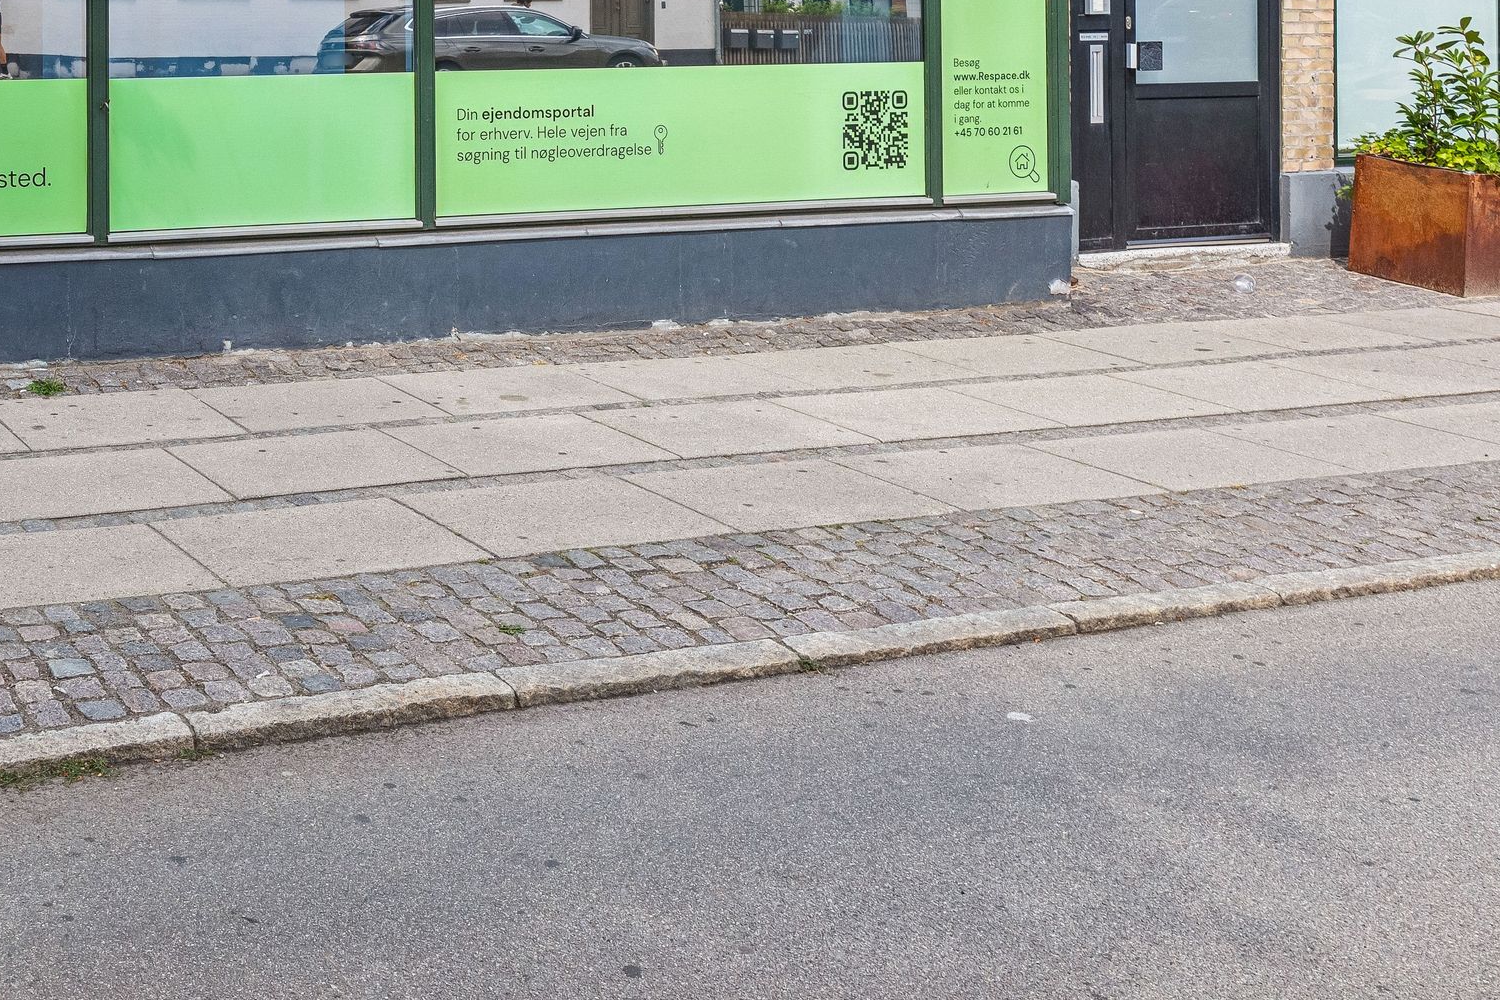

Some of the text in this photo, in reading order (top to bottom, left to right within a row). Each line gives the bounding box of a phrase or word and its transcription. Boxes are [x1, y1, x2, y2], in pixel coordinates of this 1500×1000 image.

[953, 57, 981, 70] Besøg
[953, 70, 1031, 83] www.Respace.dk
[953, 85, 1025, 96] eller kontakt os i
[953, 99, 1030, 112] dag for at komme
[457, 104, 595, 124] Din ejendomsportal
[954, 114, 982, 126] i gang.
[456, 123, 628, 142] for erhverv. Hele vejen fra
[954, 125, 1023, 138] +45 70 60 21 61
[456, 142, 652, 164] søgning til nøgleoverdragelse
